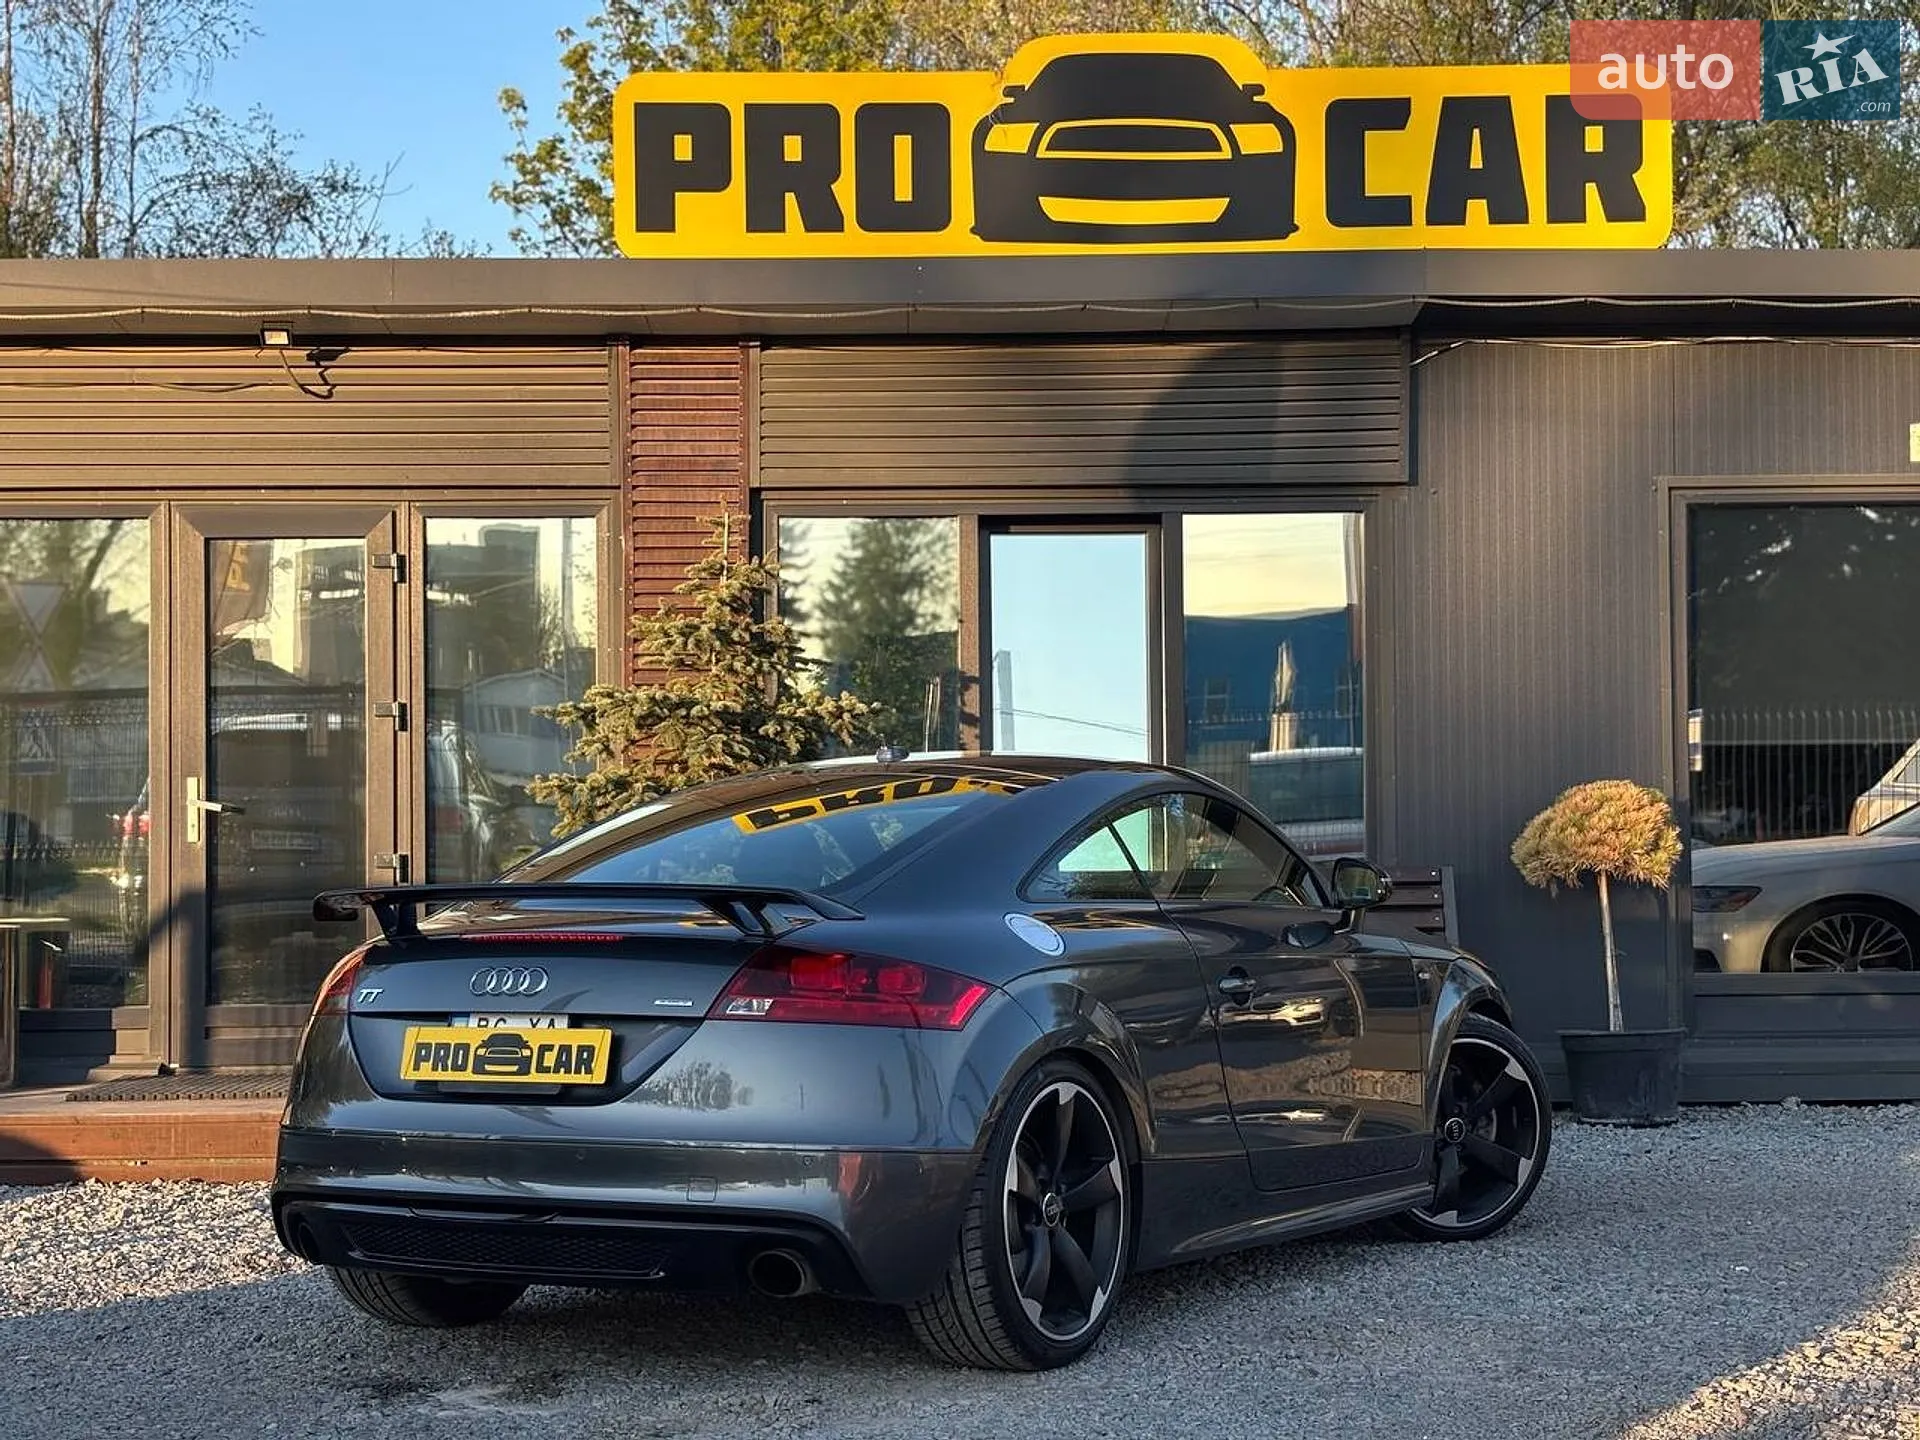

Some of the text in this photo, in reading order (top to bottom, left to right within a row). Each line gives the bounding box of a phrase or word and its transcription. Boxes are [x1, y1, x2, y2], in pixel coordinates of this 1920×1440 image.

[634, 94, 1646, 233] PRO CAR
[358, 988, 384, 1002] TT
[412, 1042, 596, 1075] PRO CAR
